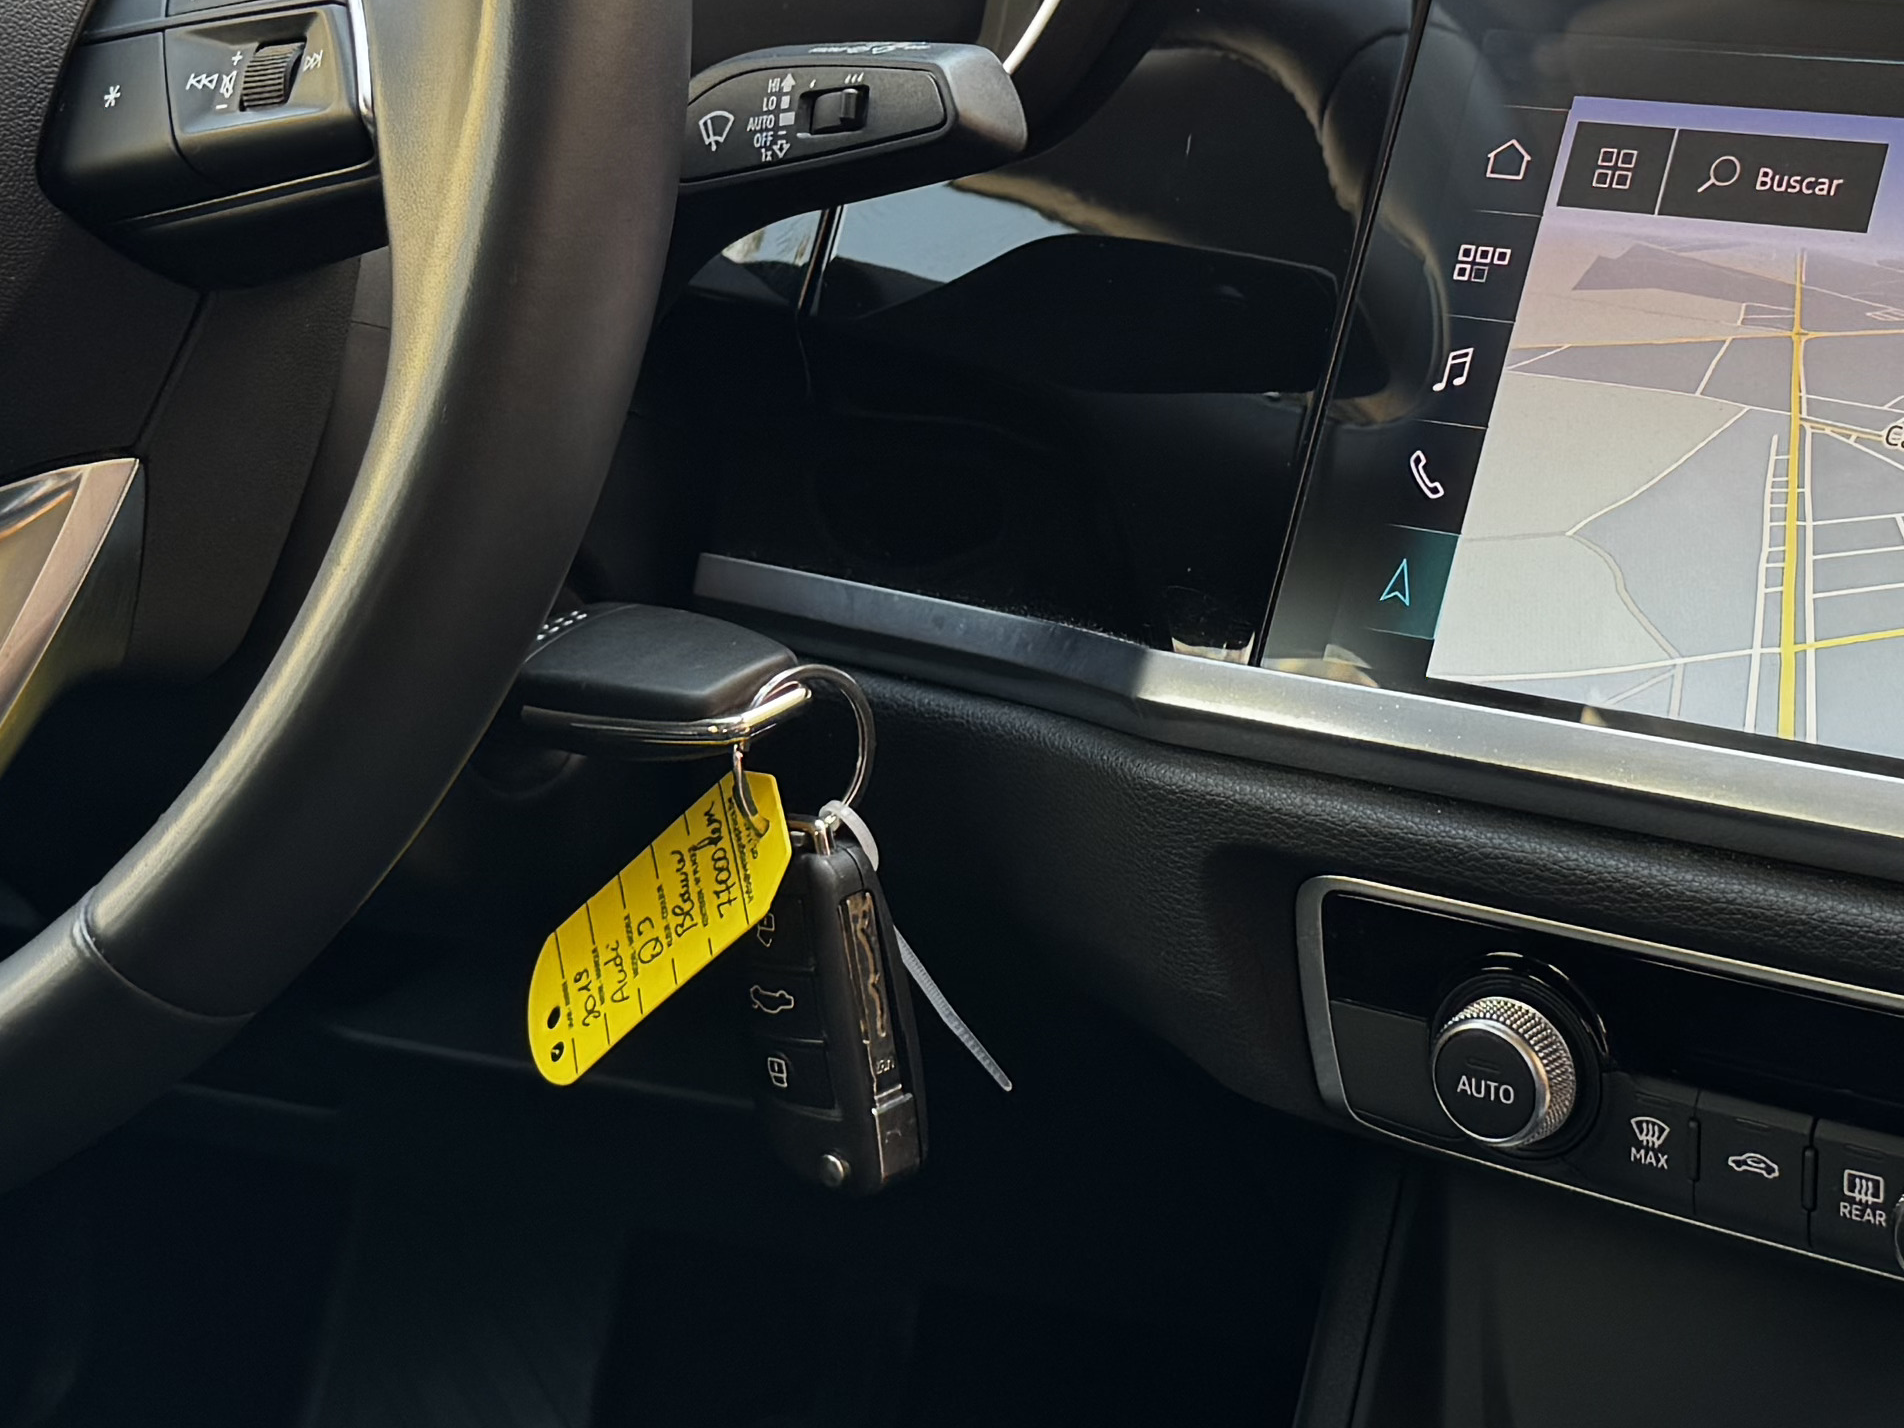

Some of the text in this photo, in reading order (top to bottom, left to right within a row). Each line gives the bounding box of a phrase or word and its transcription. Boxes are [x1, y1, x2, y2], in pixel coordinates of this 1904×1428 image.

[768, 78, 781, 93] HI
[763, 97, 777, 112] LO
[746, 115, 775, 131] AUTO
[753, 132, 774, 148] OFF
[1755, 167, 1843, 197] Buscar
[603, 939, 631, 1004] Audi
[1457, 1075, 1515, 1105] AUTO
[1630, 1147, 1669, 1171] MAX
[1839, 1201, 1887, 1228] REAR
